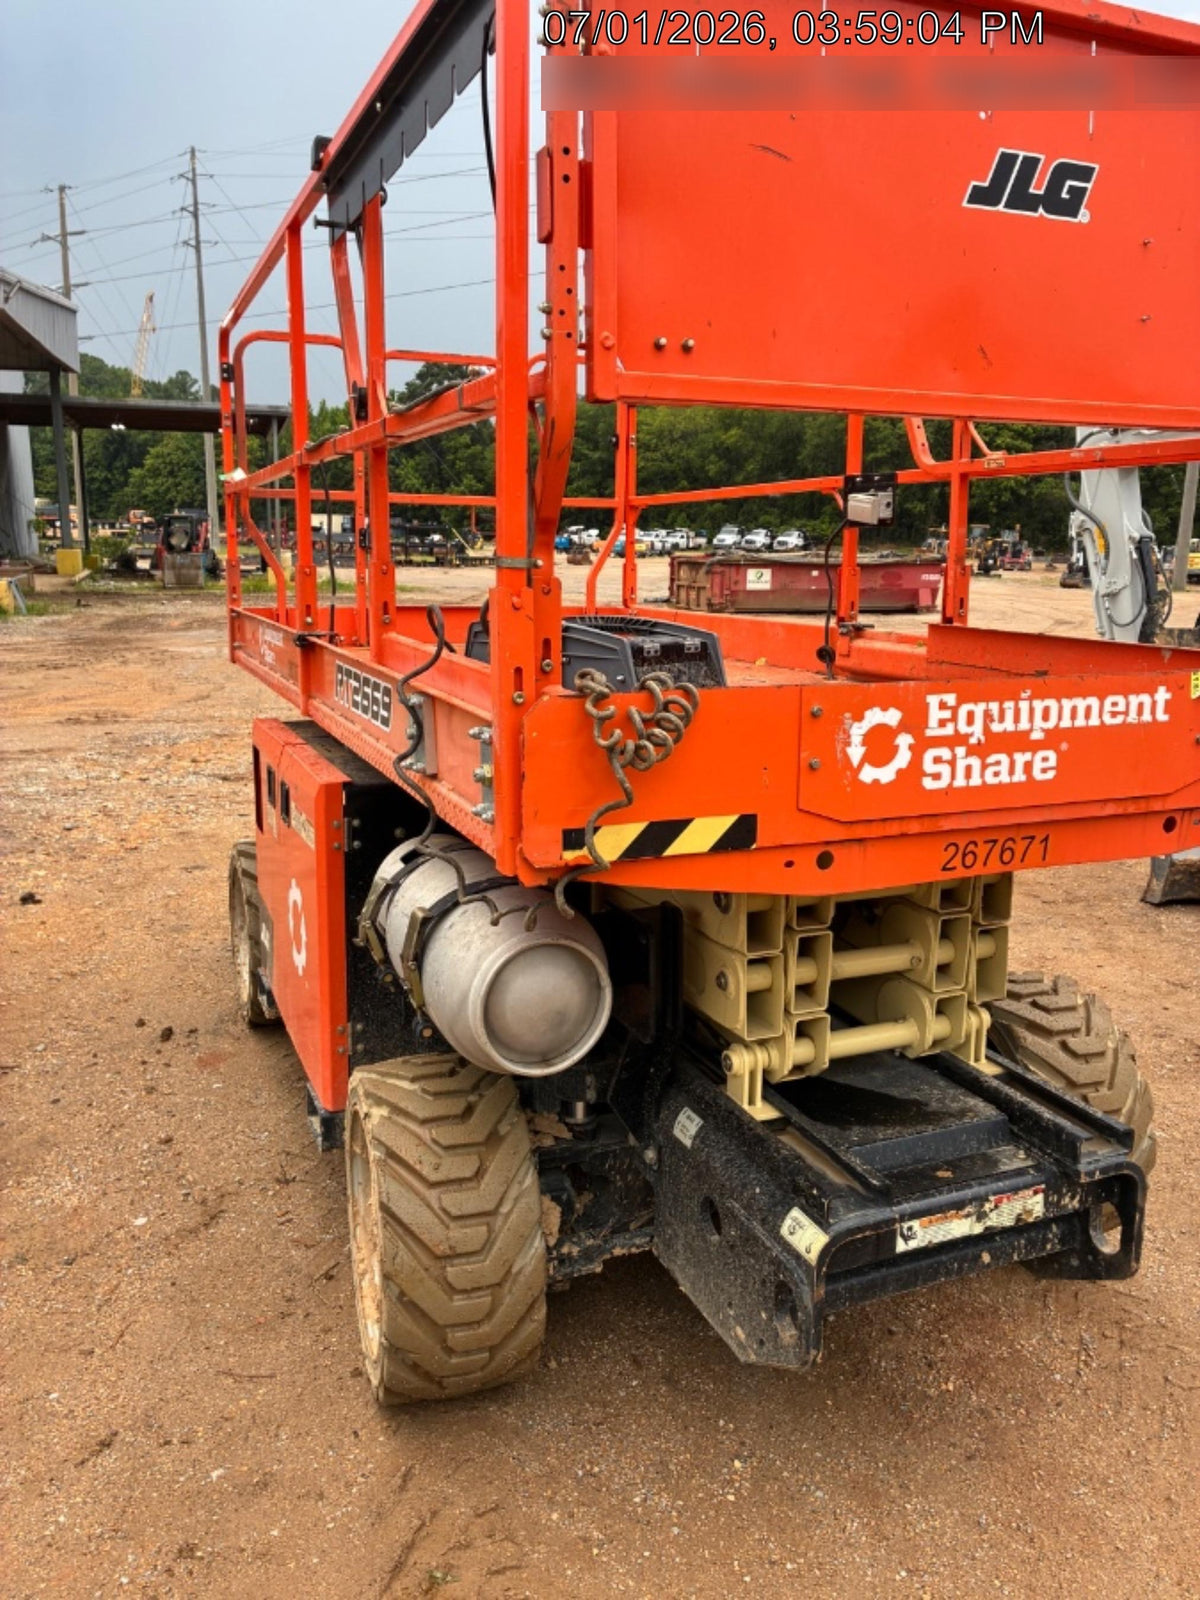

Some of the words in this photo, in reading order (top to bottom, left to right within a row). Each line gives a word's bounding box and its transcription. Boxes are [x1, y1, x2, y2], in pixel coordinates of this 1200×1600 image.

[962, 147, 1099, 222] JLG
[334, 660, 392, 732] RT2669
[925, 685, 1172, 744] Equipment
[922, 746, 1057, 790] Share
[940, 834, 1051, 872] 267671
